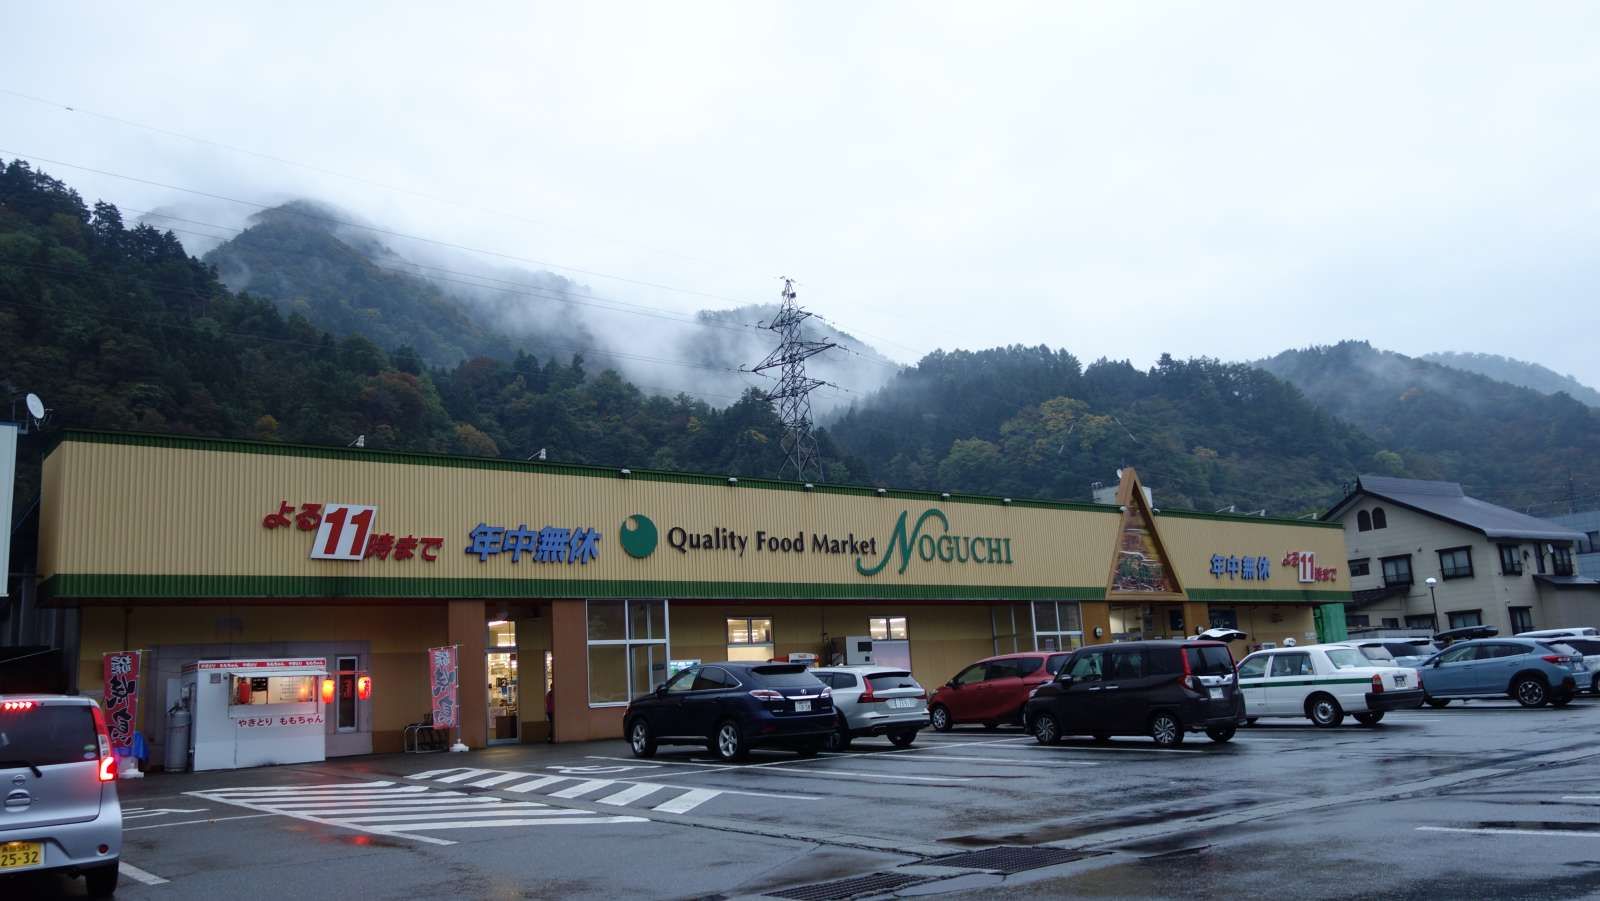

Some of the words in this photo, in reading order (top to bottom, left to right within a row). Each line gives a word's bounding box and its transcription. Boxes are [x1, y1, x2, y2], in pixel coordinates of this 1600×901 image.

[263, 500, 445, 562] よる11時まで
[465, 522, 602, 564] 年中無休
[667, 526, 748, 557] Quality
[756, 530, 805, 553] Food
[811, 533, 877, 555] Market
[1210, 553, 1270, 581] 年中無休
[238, 717, 273, 728] やきとり
[279, 714, 323, 726] ももちゃん
[1, 850, 39, 867] 25-32
